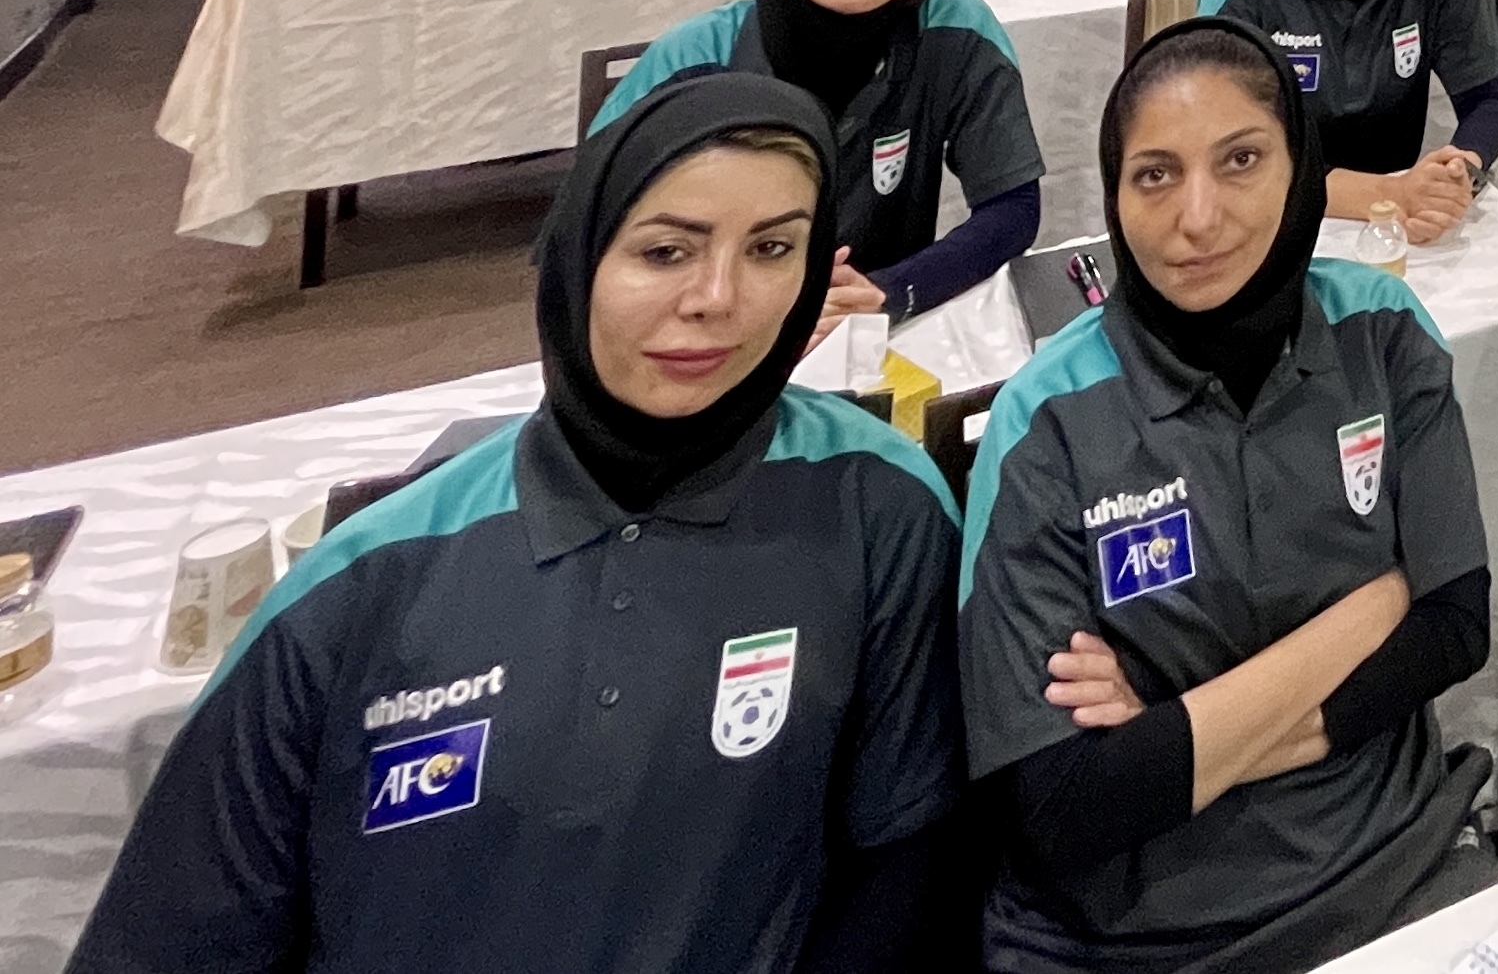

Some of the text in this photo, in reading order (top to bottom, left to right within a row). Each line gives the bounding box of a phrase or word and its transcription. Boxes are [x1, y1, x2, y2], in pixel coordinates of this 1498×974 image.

[1082, 476, 1189, 529] uhlsport
[1115, 536, 1178, 585] AFC
[363, 664, 506, 731] uhlsport
[371, 752, 465, 810] AFC
